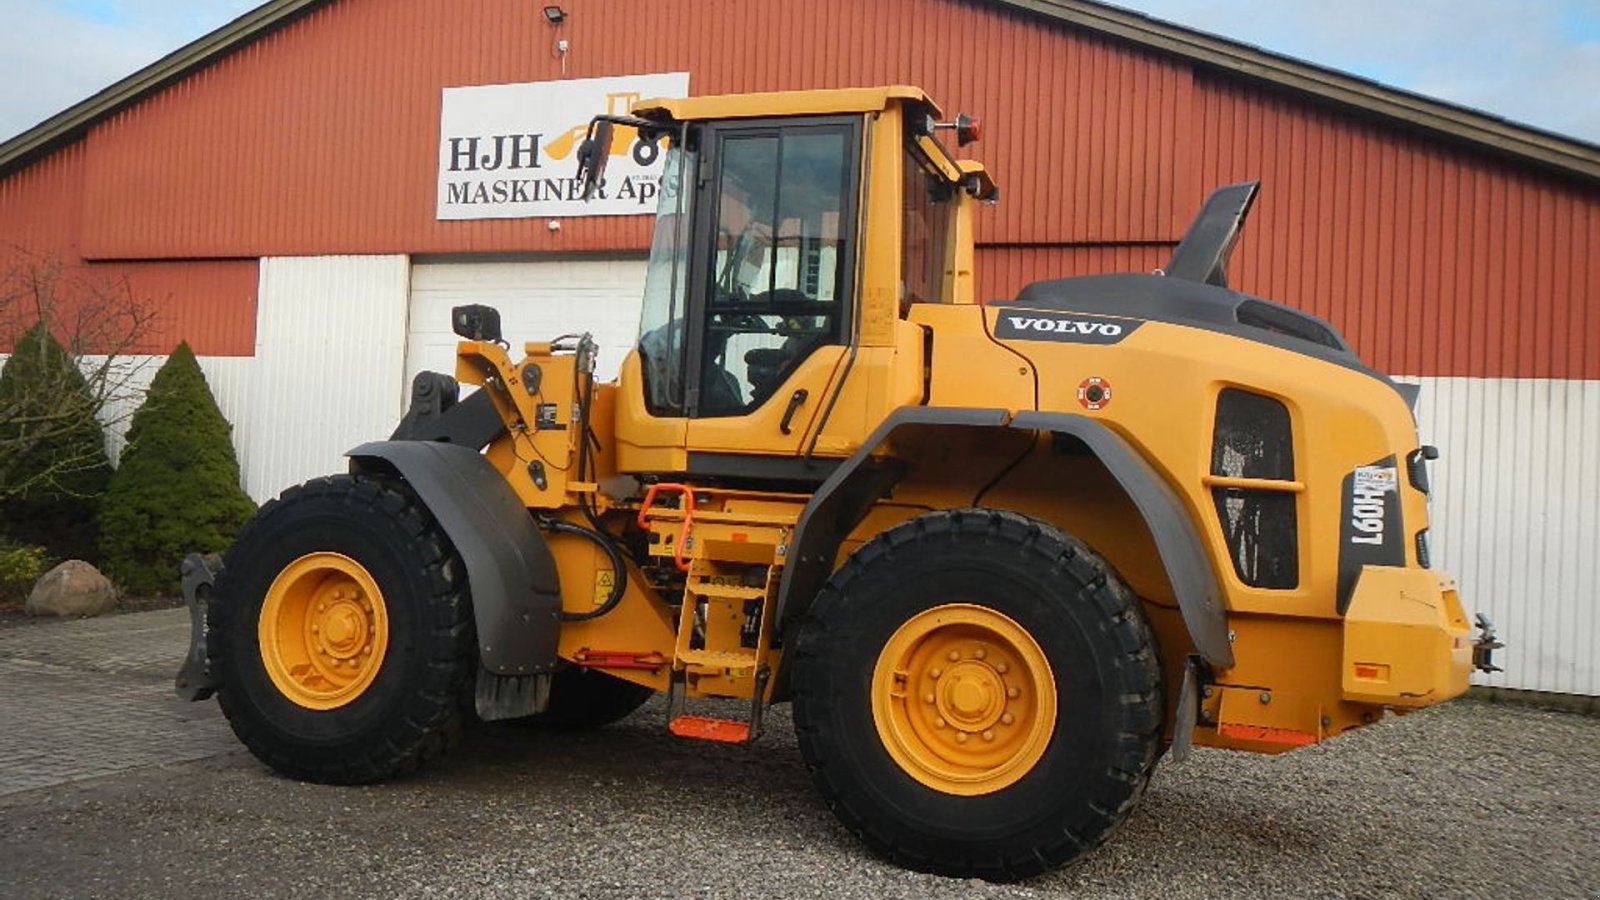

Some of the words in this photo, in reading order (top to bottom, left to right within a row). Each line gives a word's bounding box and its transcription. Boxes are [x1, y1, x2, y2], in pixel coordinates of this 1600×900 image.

[448, 134, 543, 172] HJH
[1008, 317, 1122, 336] VOLVO
[1351, 489, 1385, 545] L60H
